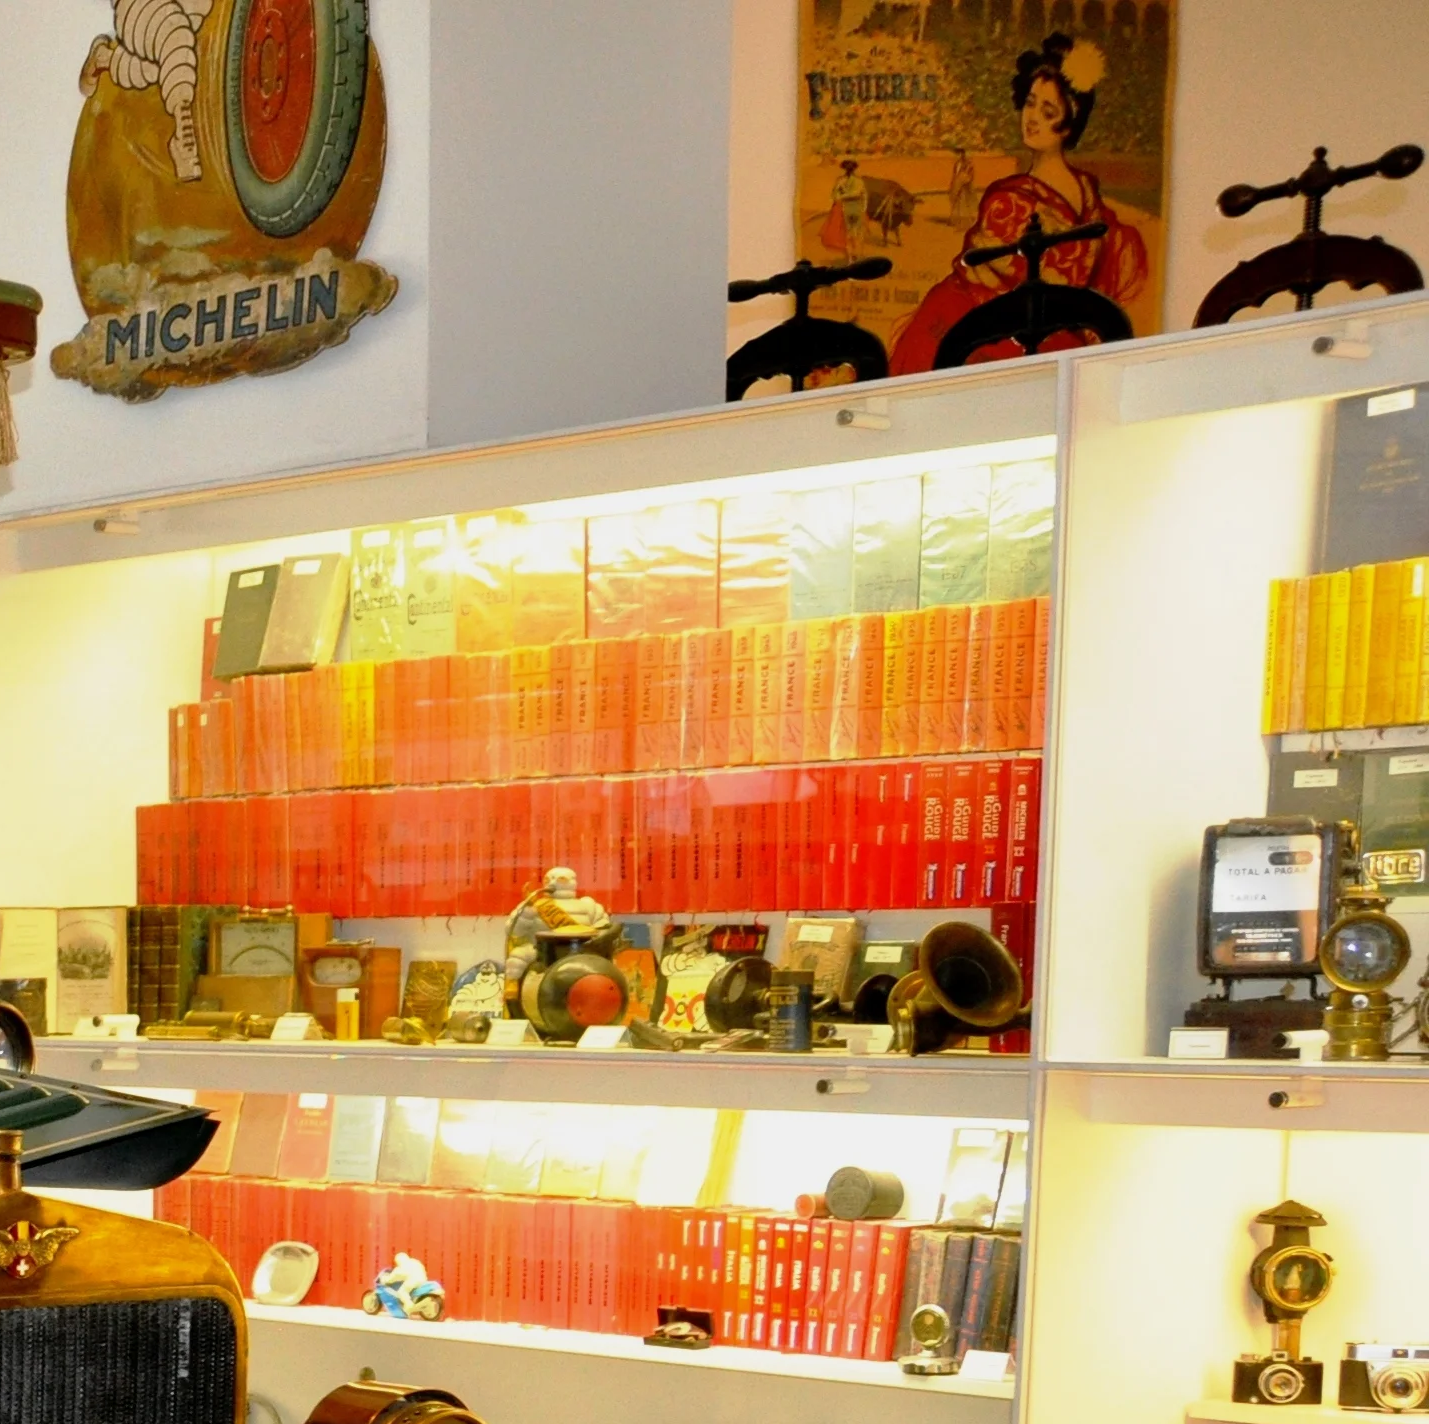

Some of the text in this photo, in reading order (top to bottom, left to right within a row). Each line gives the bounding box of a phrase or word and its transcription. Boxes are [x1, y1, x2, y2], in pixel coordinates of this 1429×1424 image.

[805, 71, 938, 120] FIGUERAS
[105, 270, 340, 365] MICHELIN
[736, 666, 746, 711] FRANCE
[761, 663, 769, 710] FRANCE
[785, 660, 796, 708] FRANCE
[813, 658, 822, 704] FRANCE
[865, 655, 874, 704] FRANCE
[886, 652, 896, 701] FRANCE
[926, 647, 936, 697] FRANCE
[948, 646, 958, 696] FRANCE
[994, 642, 1004, 693] FRANCE
[1015, 642, 1026, 693] FRANCE
[924, 797, 937, 842] ROUGE
[934, 803, 943, 840] GUIDE
[952, 797, 965, 843] ROUGE
[962, 803, 972, 841] GUIDE
[982, 795, 995, 840] ROUGE
[992, 801, 1002, 838] GUIDE
[1228, 867, 1260, 876] TOTAL
